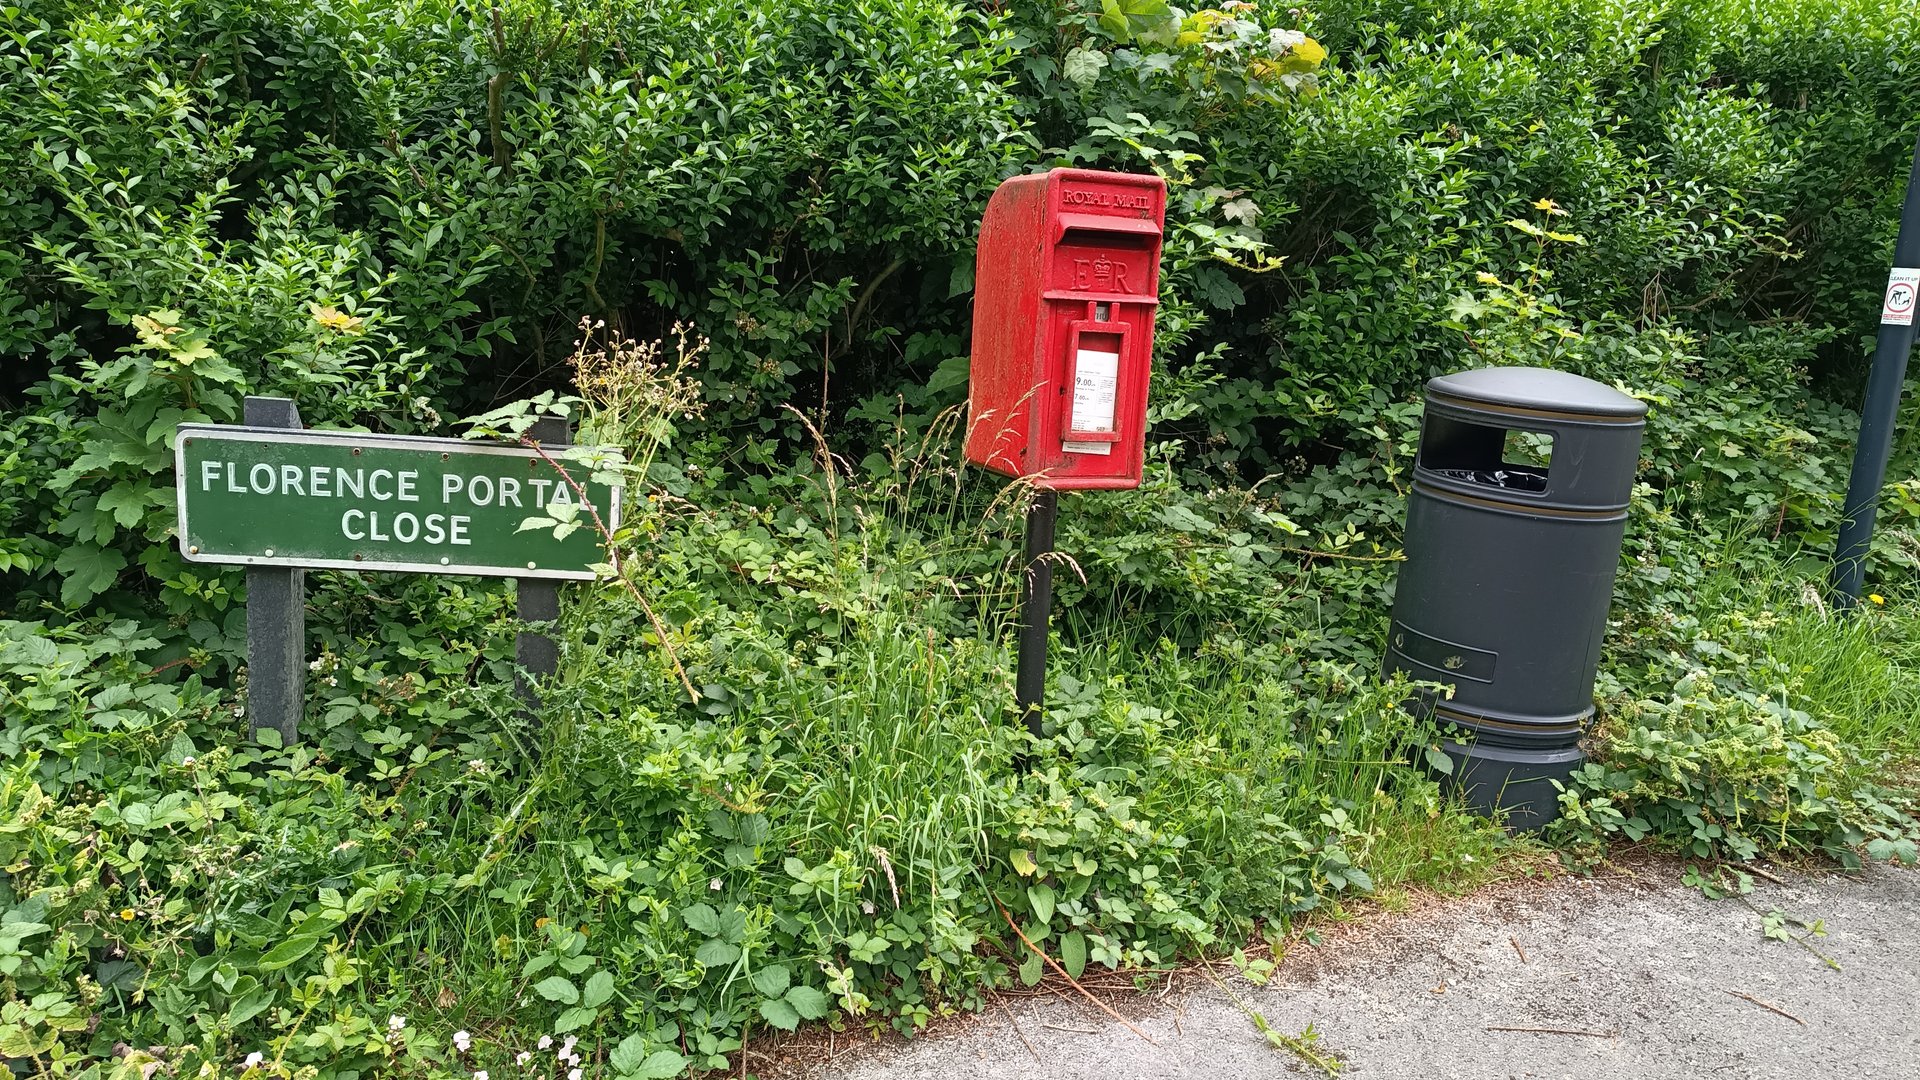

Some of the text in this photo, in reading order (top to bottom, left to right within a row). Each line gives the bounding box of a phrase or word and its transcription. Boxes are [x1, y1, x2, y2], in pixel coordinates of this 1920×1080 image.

[1063, 189, 1151, 209] ROYAL MAIL
[201, 460, 598, 512] FLORENCE PORTAL
[341, 508, 472, 545] CLOSE
